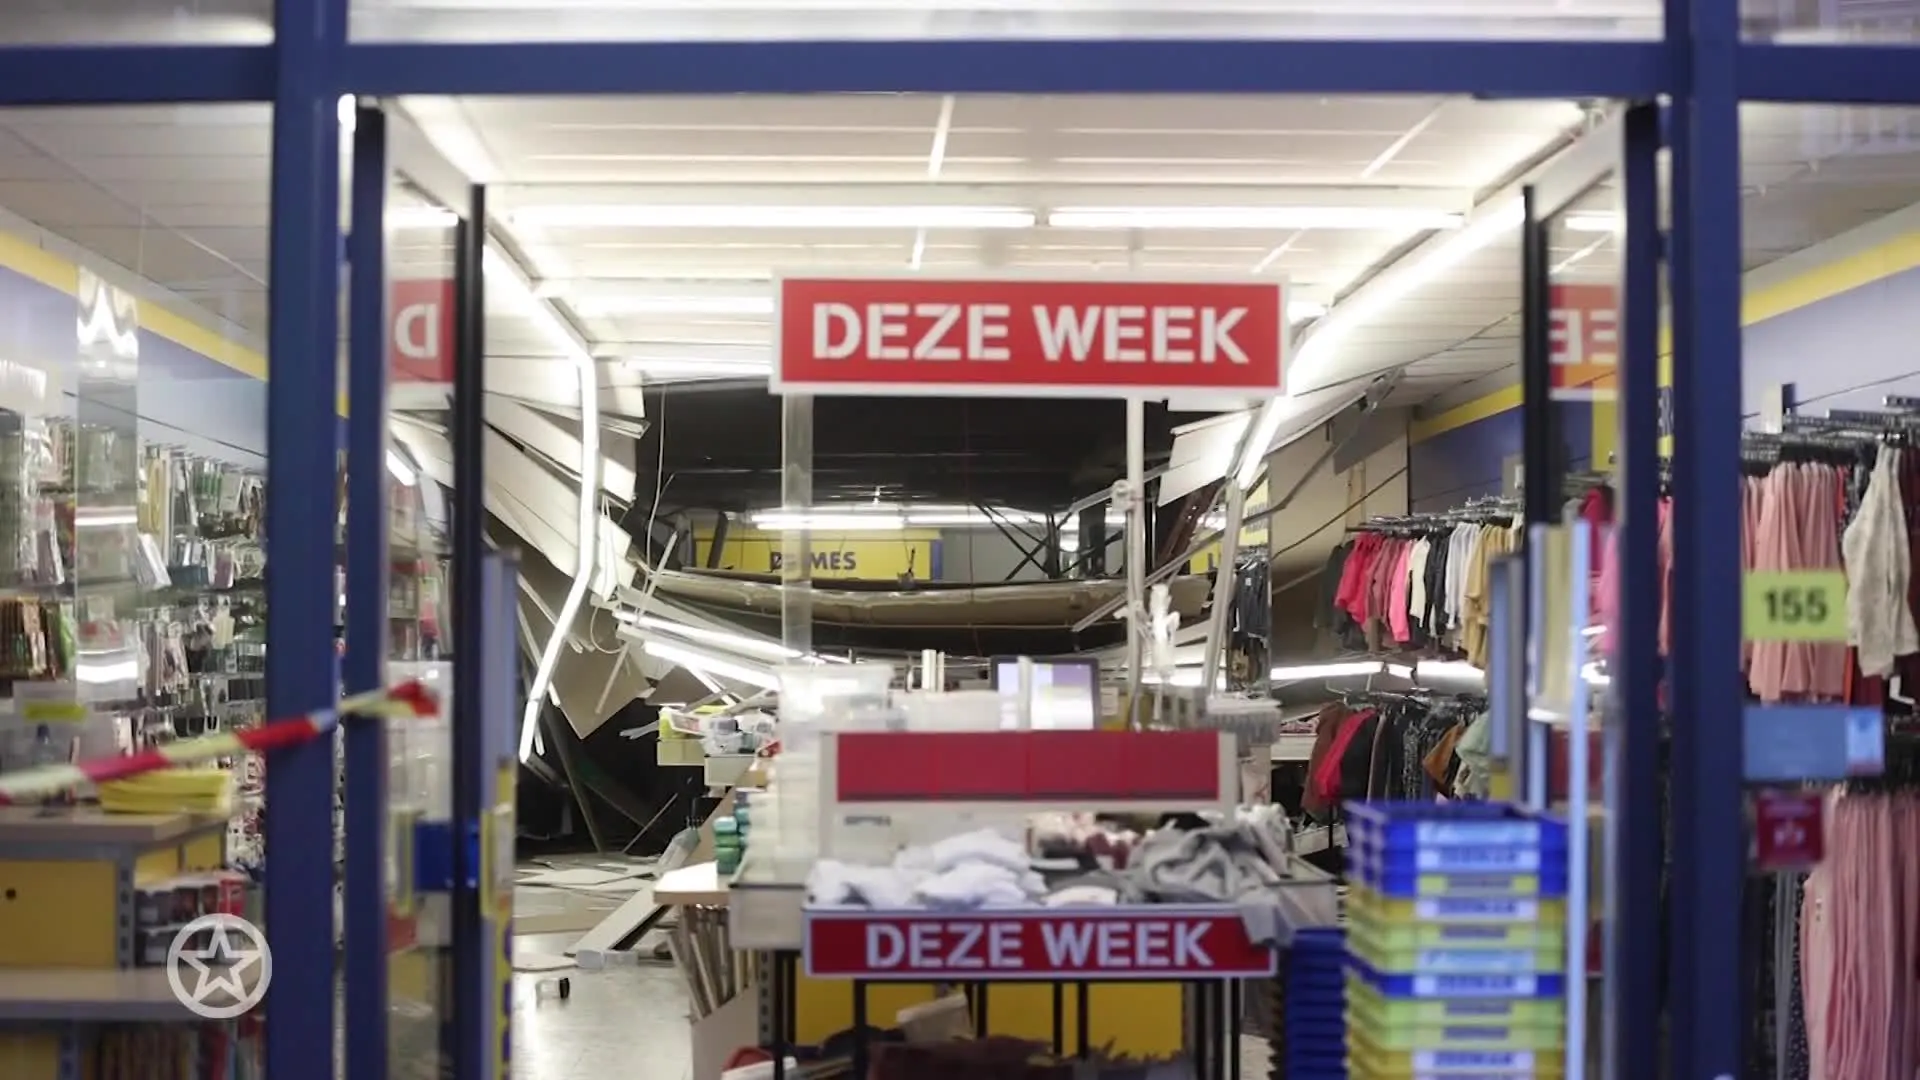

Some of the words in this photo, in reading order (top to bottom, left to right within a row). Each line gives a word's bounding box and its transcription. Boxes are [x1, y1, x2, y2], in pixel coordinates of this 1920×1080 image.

[812, 302, 1011, 361] DEZE
[1032, 304, 1250, 364] WEEK
[1764, 588, 1829, 623] 155
[866, 922, 1023, 968] DEZE
[1040, 922, 1213, 967] WEEK
